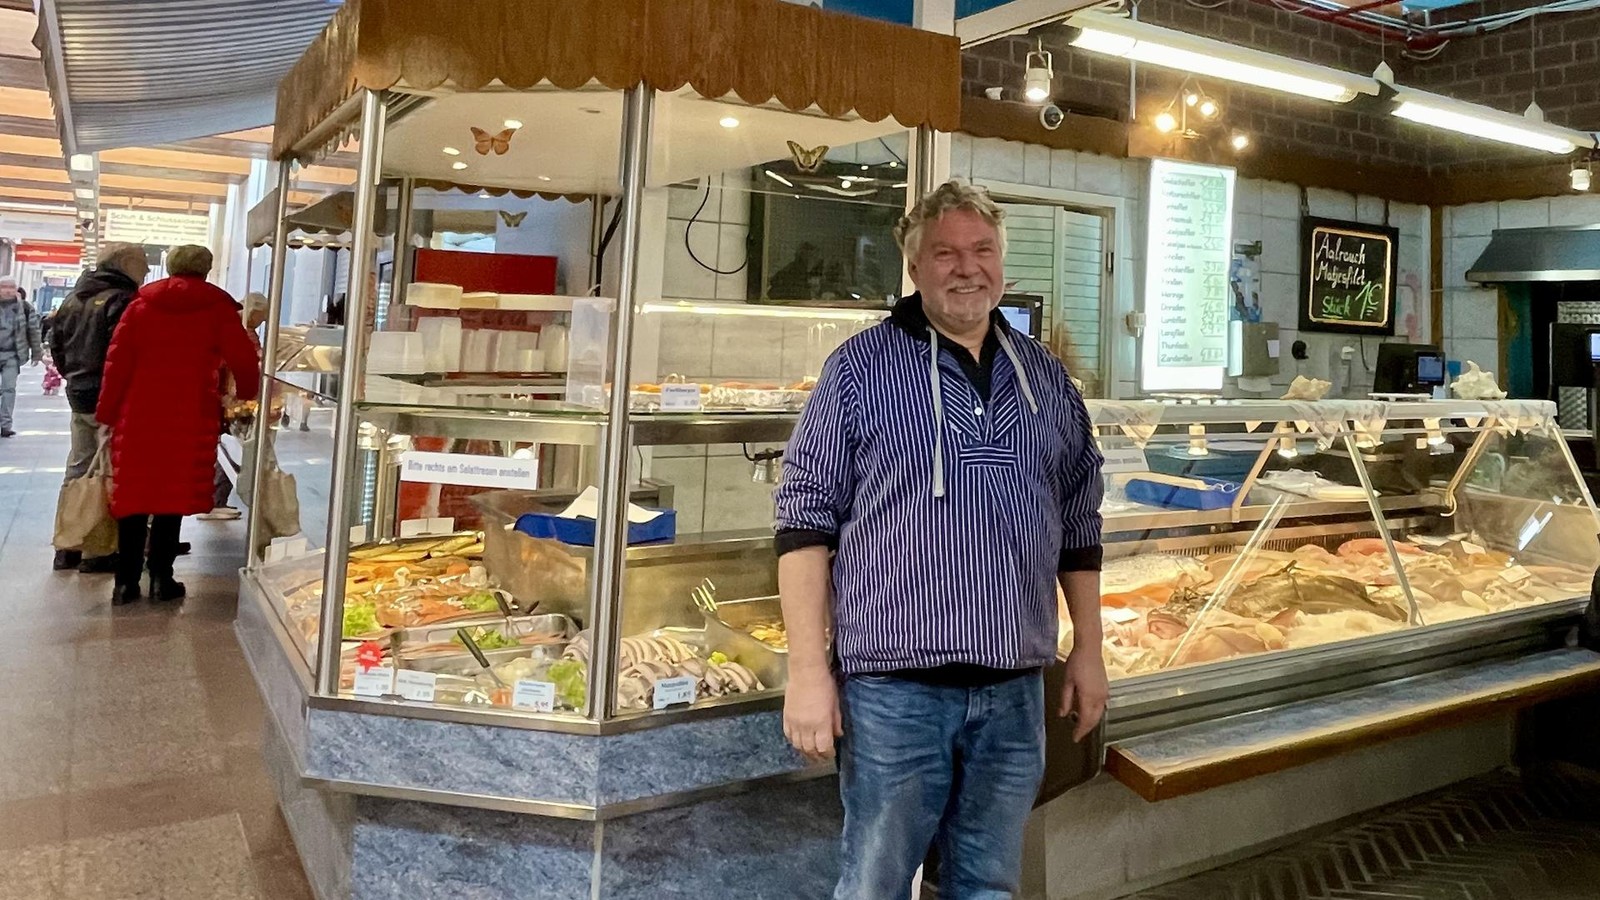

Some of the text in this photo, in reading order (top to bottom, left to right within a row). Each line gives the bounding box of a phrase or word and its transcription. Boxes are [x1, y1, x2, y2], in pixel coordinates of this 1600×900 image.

[1315, 233, 1366, 265] Aalrauch
[1315, 261, 1366, 289] Matjesfilet
[1322, 295, 1351, 316] Stück
[407, 459, 530, 478] Bitte rechts am Salattresen anstellen
